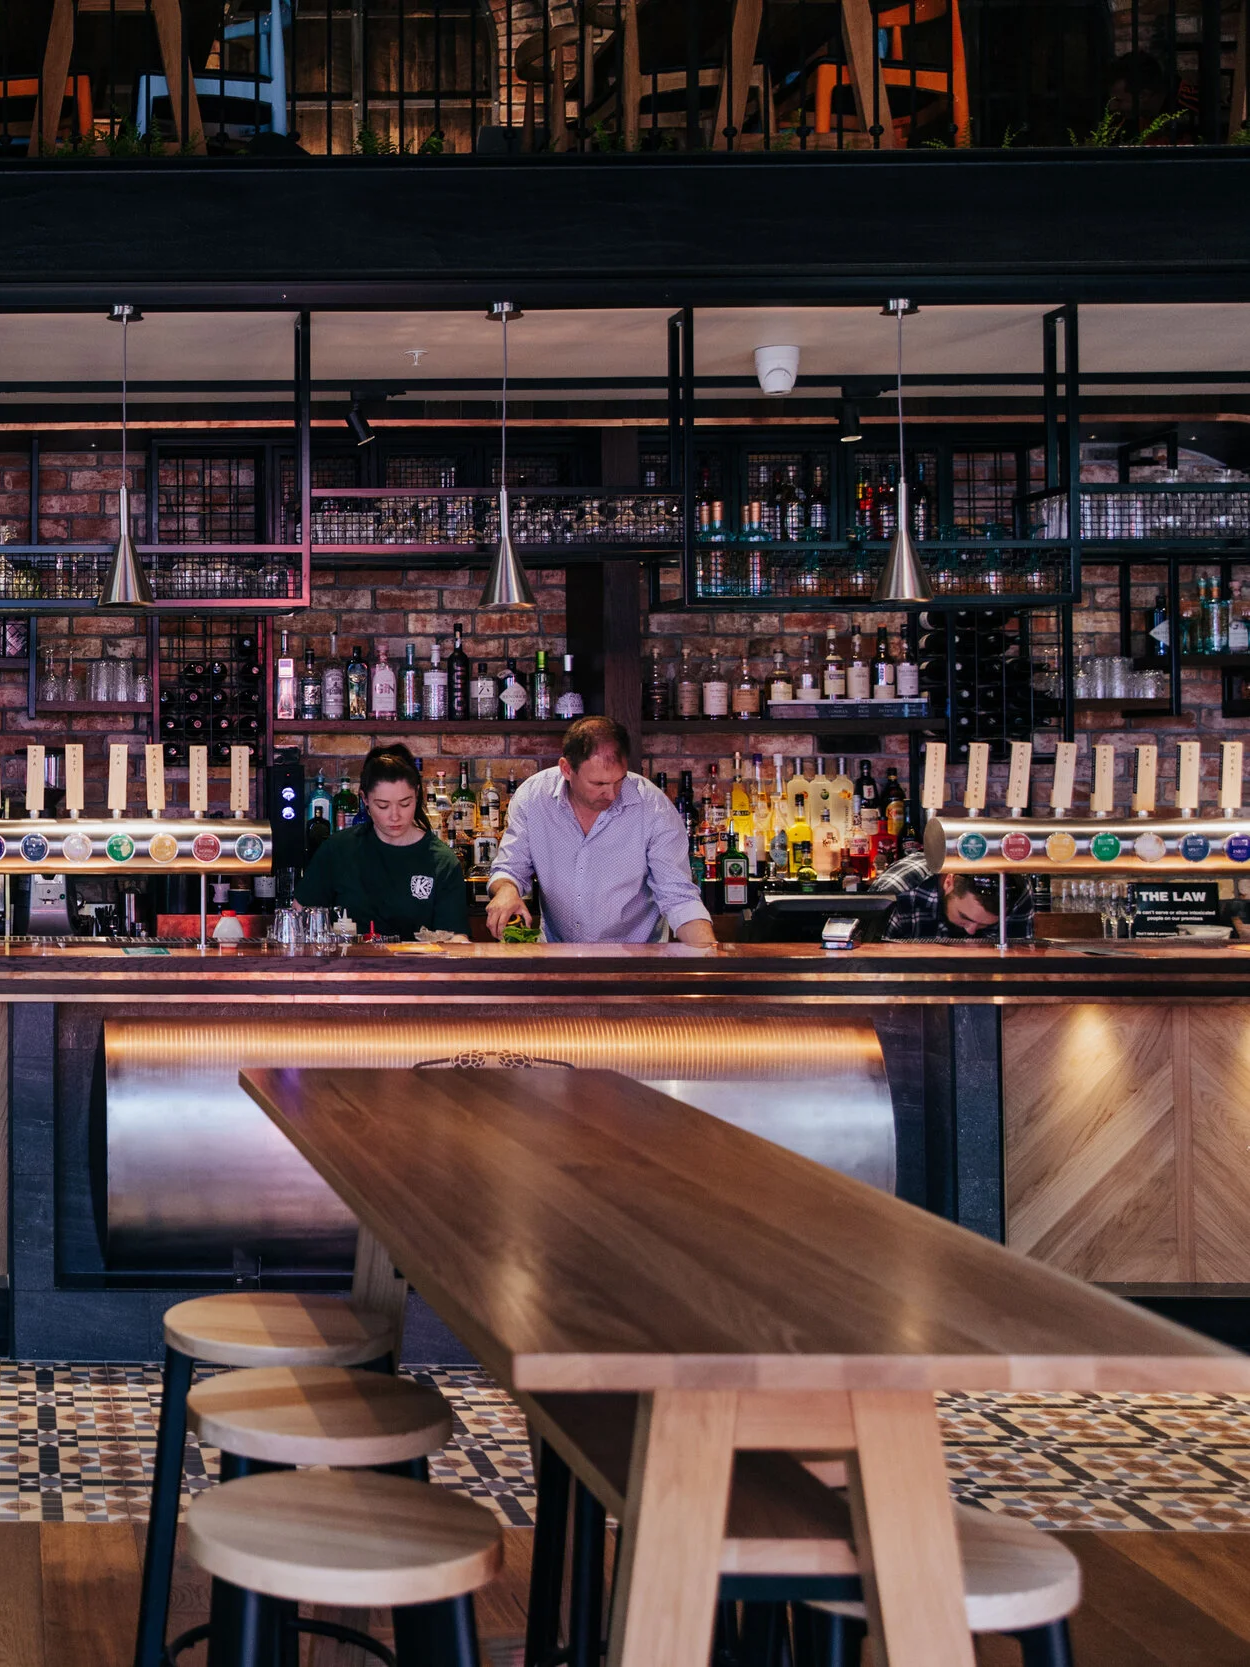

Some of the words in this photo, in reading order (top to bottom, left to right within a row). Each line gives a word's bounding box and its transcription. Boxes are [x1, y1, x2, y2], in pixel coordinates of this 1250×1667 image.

[374, 683, 396, 694] GIN
[1139, 891, 1169, 902] THE
[1172, 891, 1206, 902] LAW
